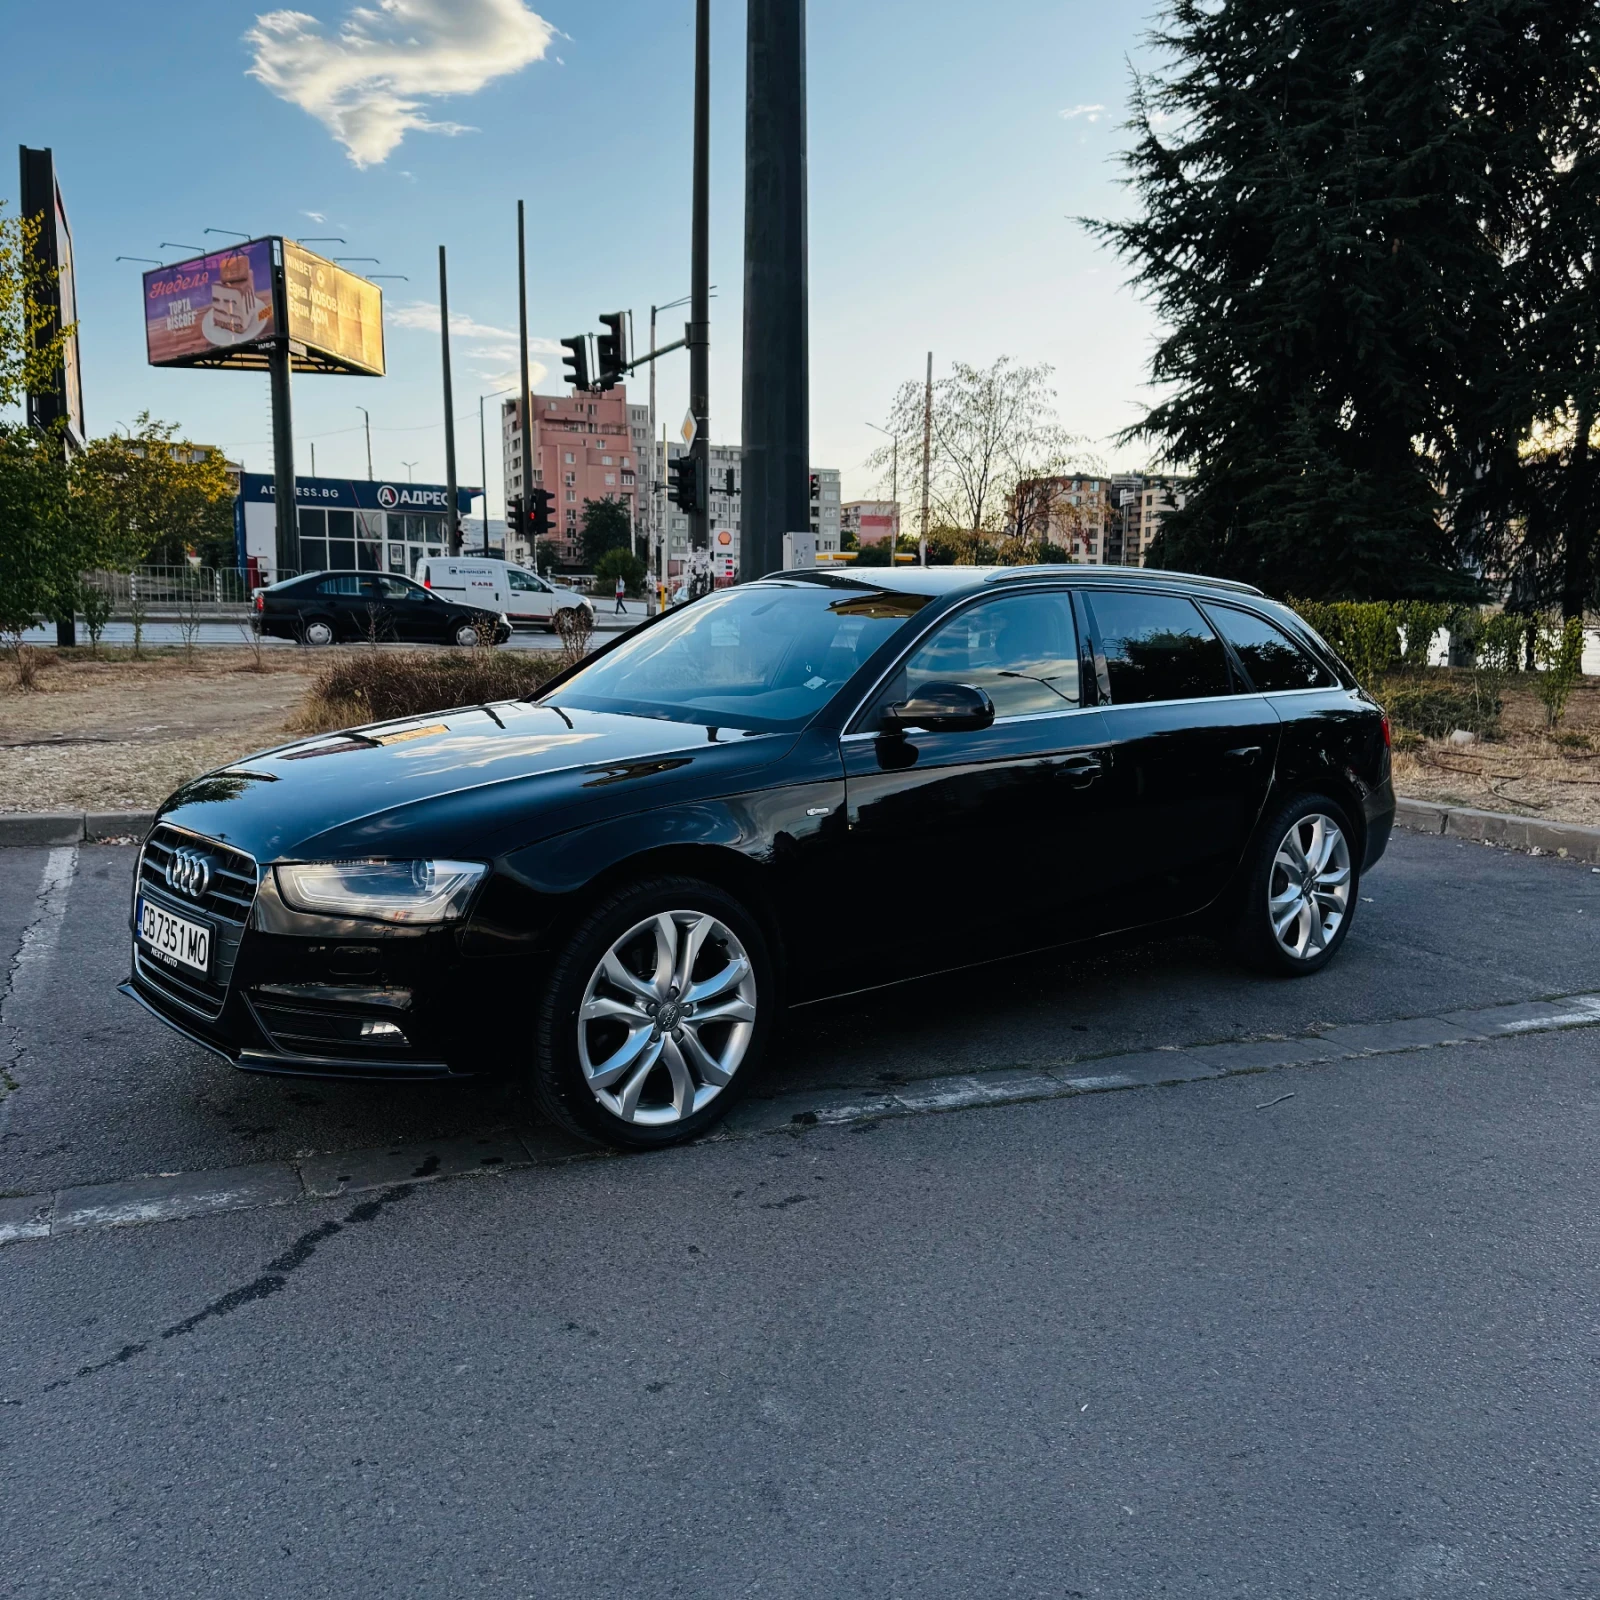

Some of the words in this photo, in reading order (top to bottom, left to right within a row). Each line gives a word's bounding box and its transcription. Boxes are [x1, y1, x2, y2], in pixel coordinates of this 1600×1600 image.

[286, 253, 312, 277] WINBET
[149, 271, 209, 299] Неделя
[168, 297, 192, 316] ТОРТА
[166, 310, 198, 331] BISCOFF
[260, 485, 339, 499] ADESS.BG
[400, 490, 449, 507] АДРЕС
[151, 947, 164, 960] NEXT
[162, 954, 178, 968] AUTO
